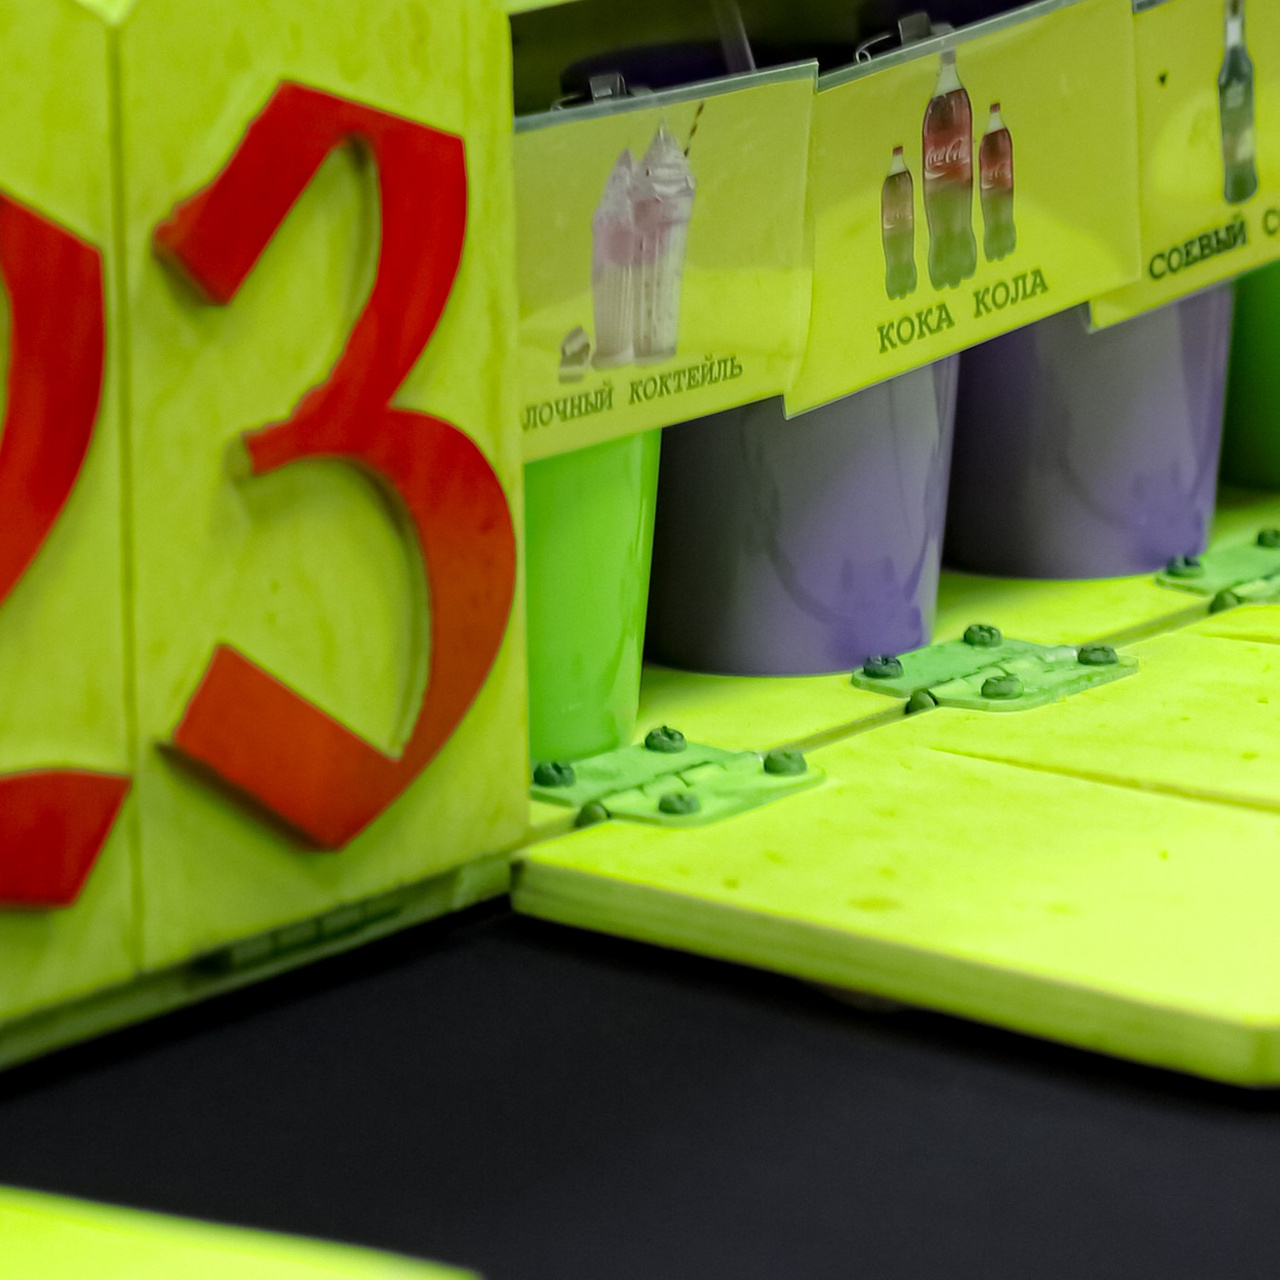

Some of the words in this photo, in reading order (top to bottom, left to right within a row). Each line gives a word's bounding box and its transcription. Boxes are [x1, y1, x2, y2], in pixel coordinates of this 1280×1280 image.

[1149, 212, 1247, 279] СОЕВЫЙ
[877, 302, 955, 354] КОКА
[972, 268, 1048, 318] КОЛА
[628, 354, 744, 405] КОКТЕЙЛЬ
